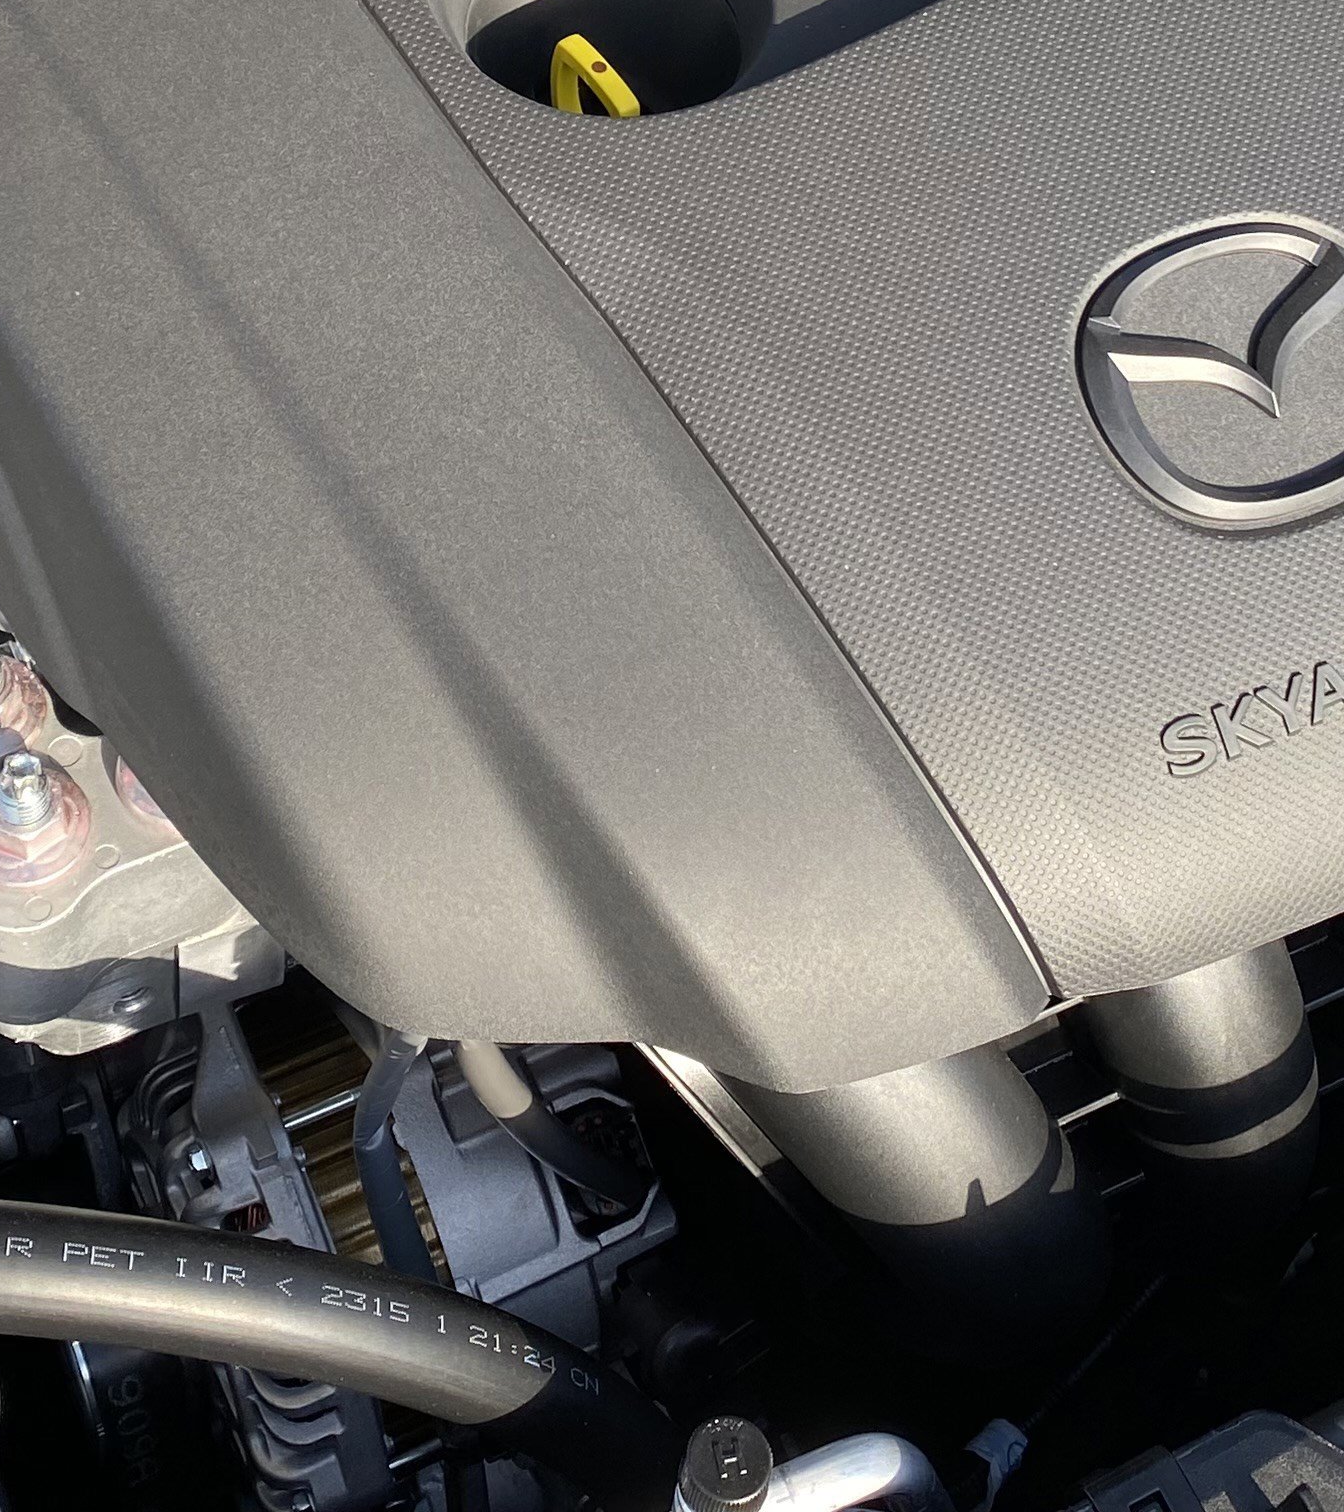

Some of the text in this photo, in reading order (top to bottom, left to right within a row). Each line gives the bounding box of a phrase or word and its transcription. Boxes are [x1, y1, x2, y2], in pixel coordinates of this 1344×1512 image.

[62, 1241, 145, 1271] PET
[321, 1284, 410, 1324] 2315
[437, 1315, 446, 1334] 1
